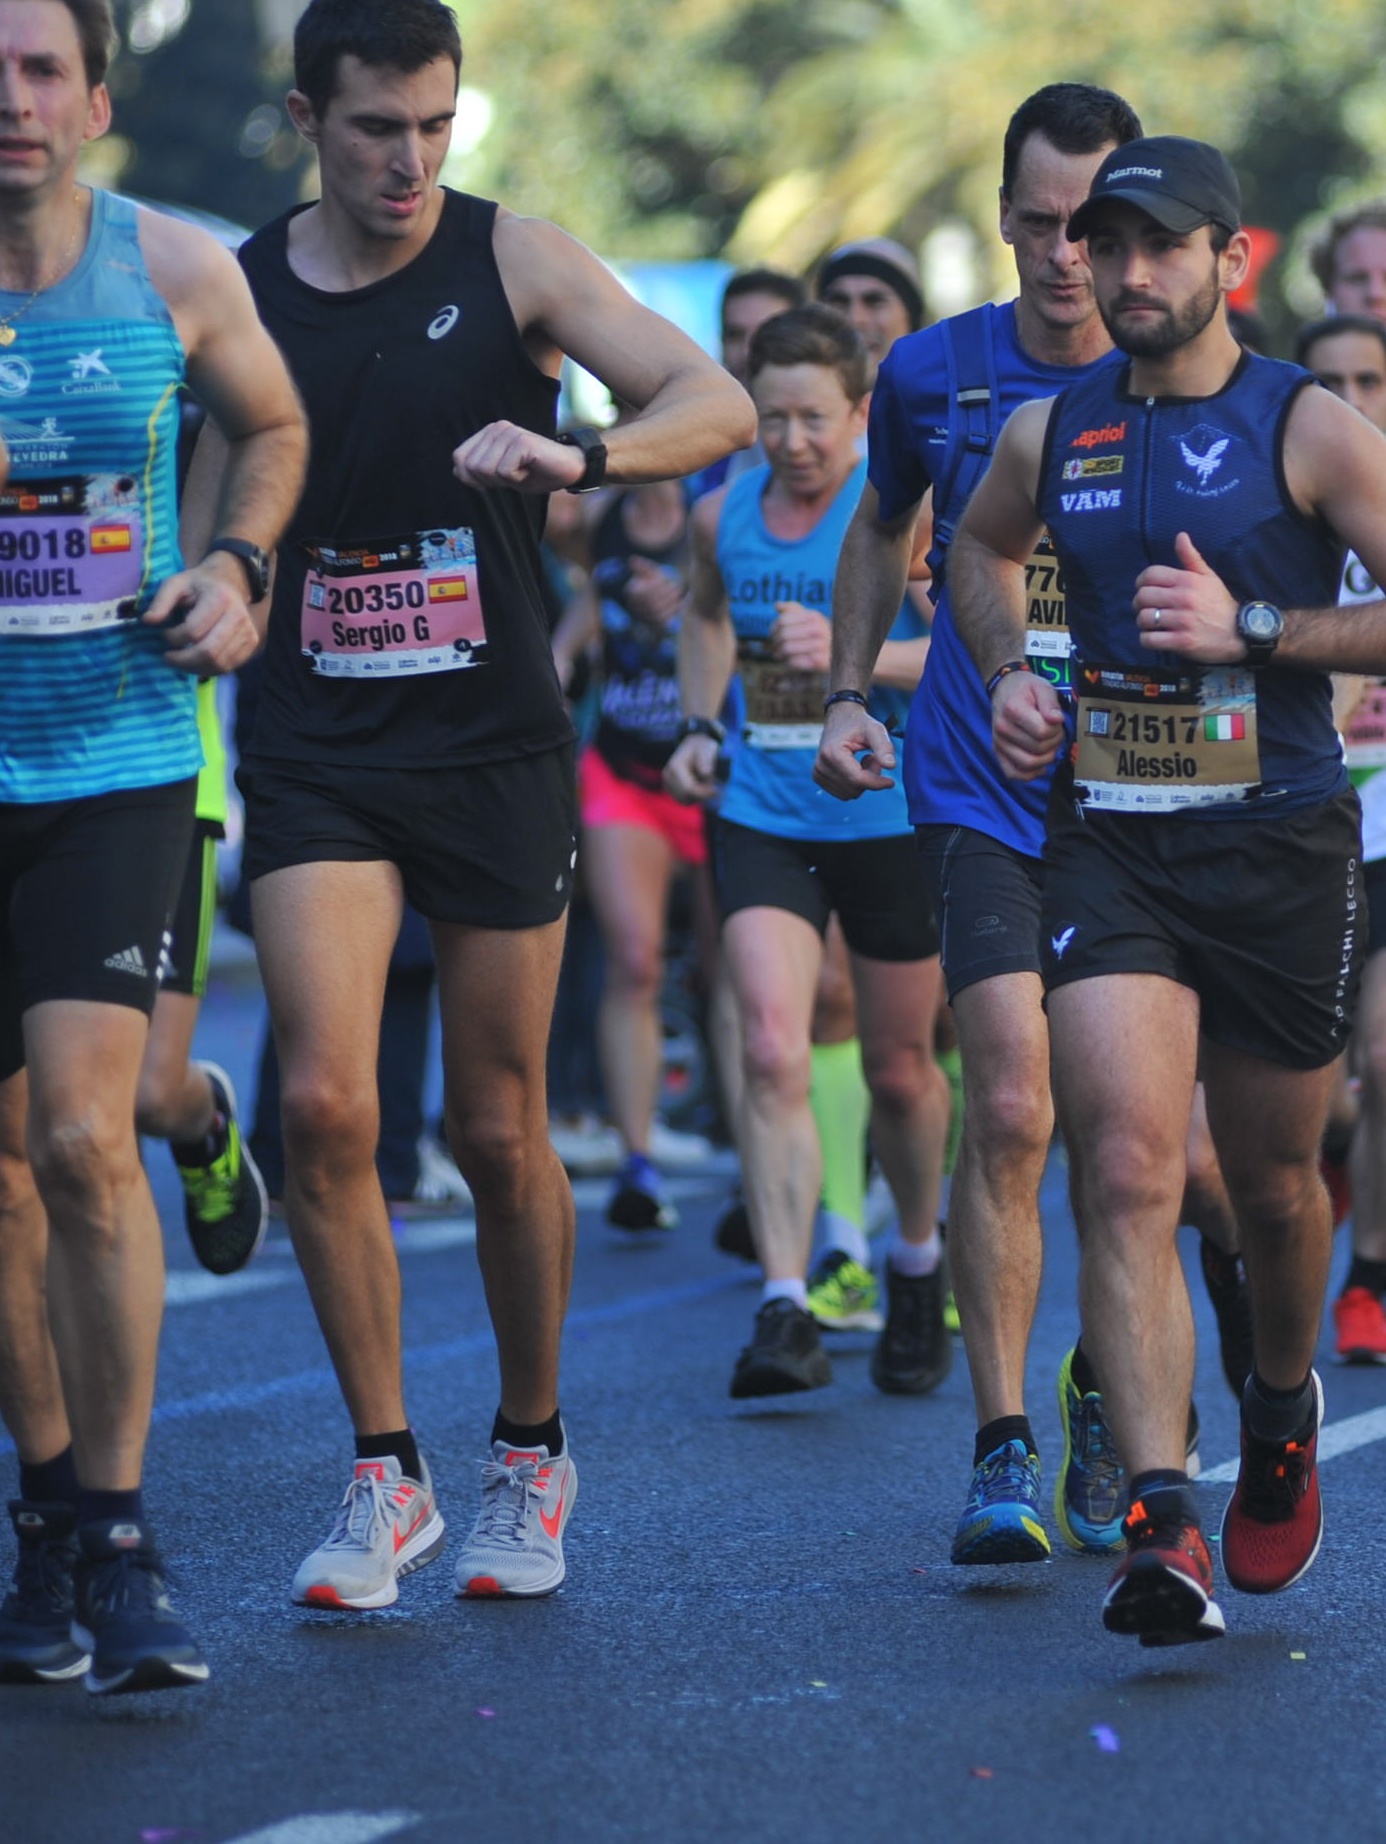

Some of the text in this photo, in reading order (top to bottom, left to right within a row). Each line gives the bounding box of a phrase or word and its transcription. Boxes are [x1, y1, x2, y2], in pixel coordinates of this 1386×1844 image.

[1105, 166, 1163, 182] Marmot
[1060, 489, 1122, 513] VAM
[379, 552, 397, 561] 2018
[0, 567, 82, 599] IGUEL
[328, 580, 425, 615] 20350
[728, 571, 832, 605] Lothia
[332, 615, 430, 651] Sergio G
[1113, 711, 1199, 744] 21517
[1116, 749, 1198, 778] Alessio
[1346, 858, 1357, 921] LECCO
